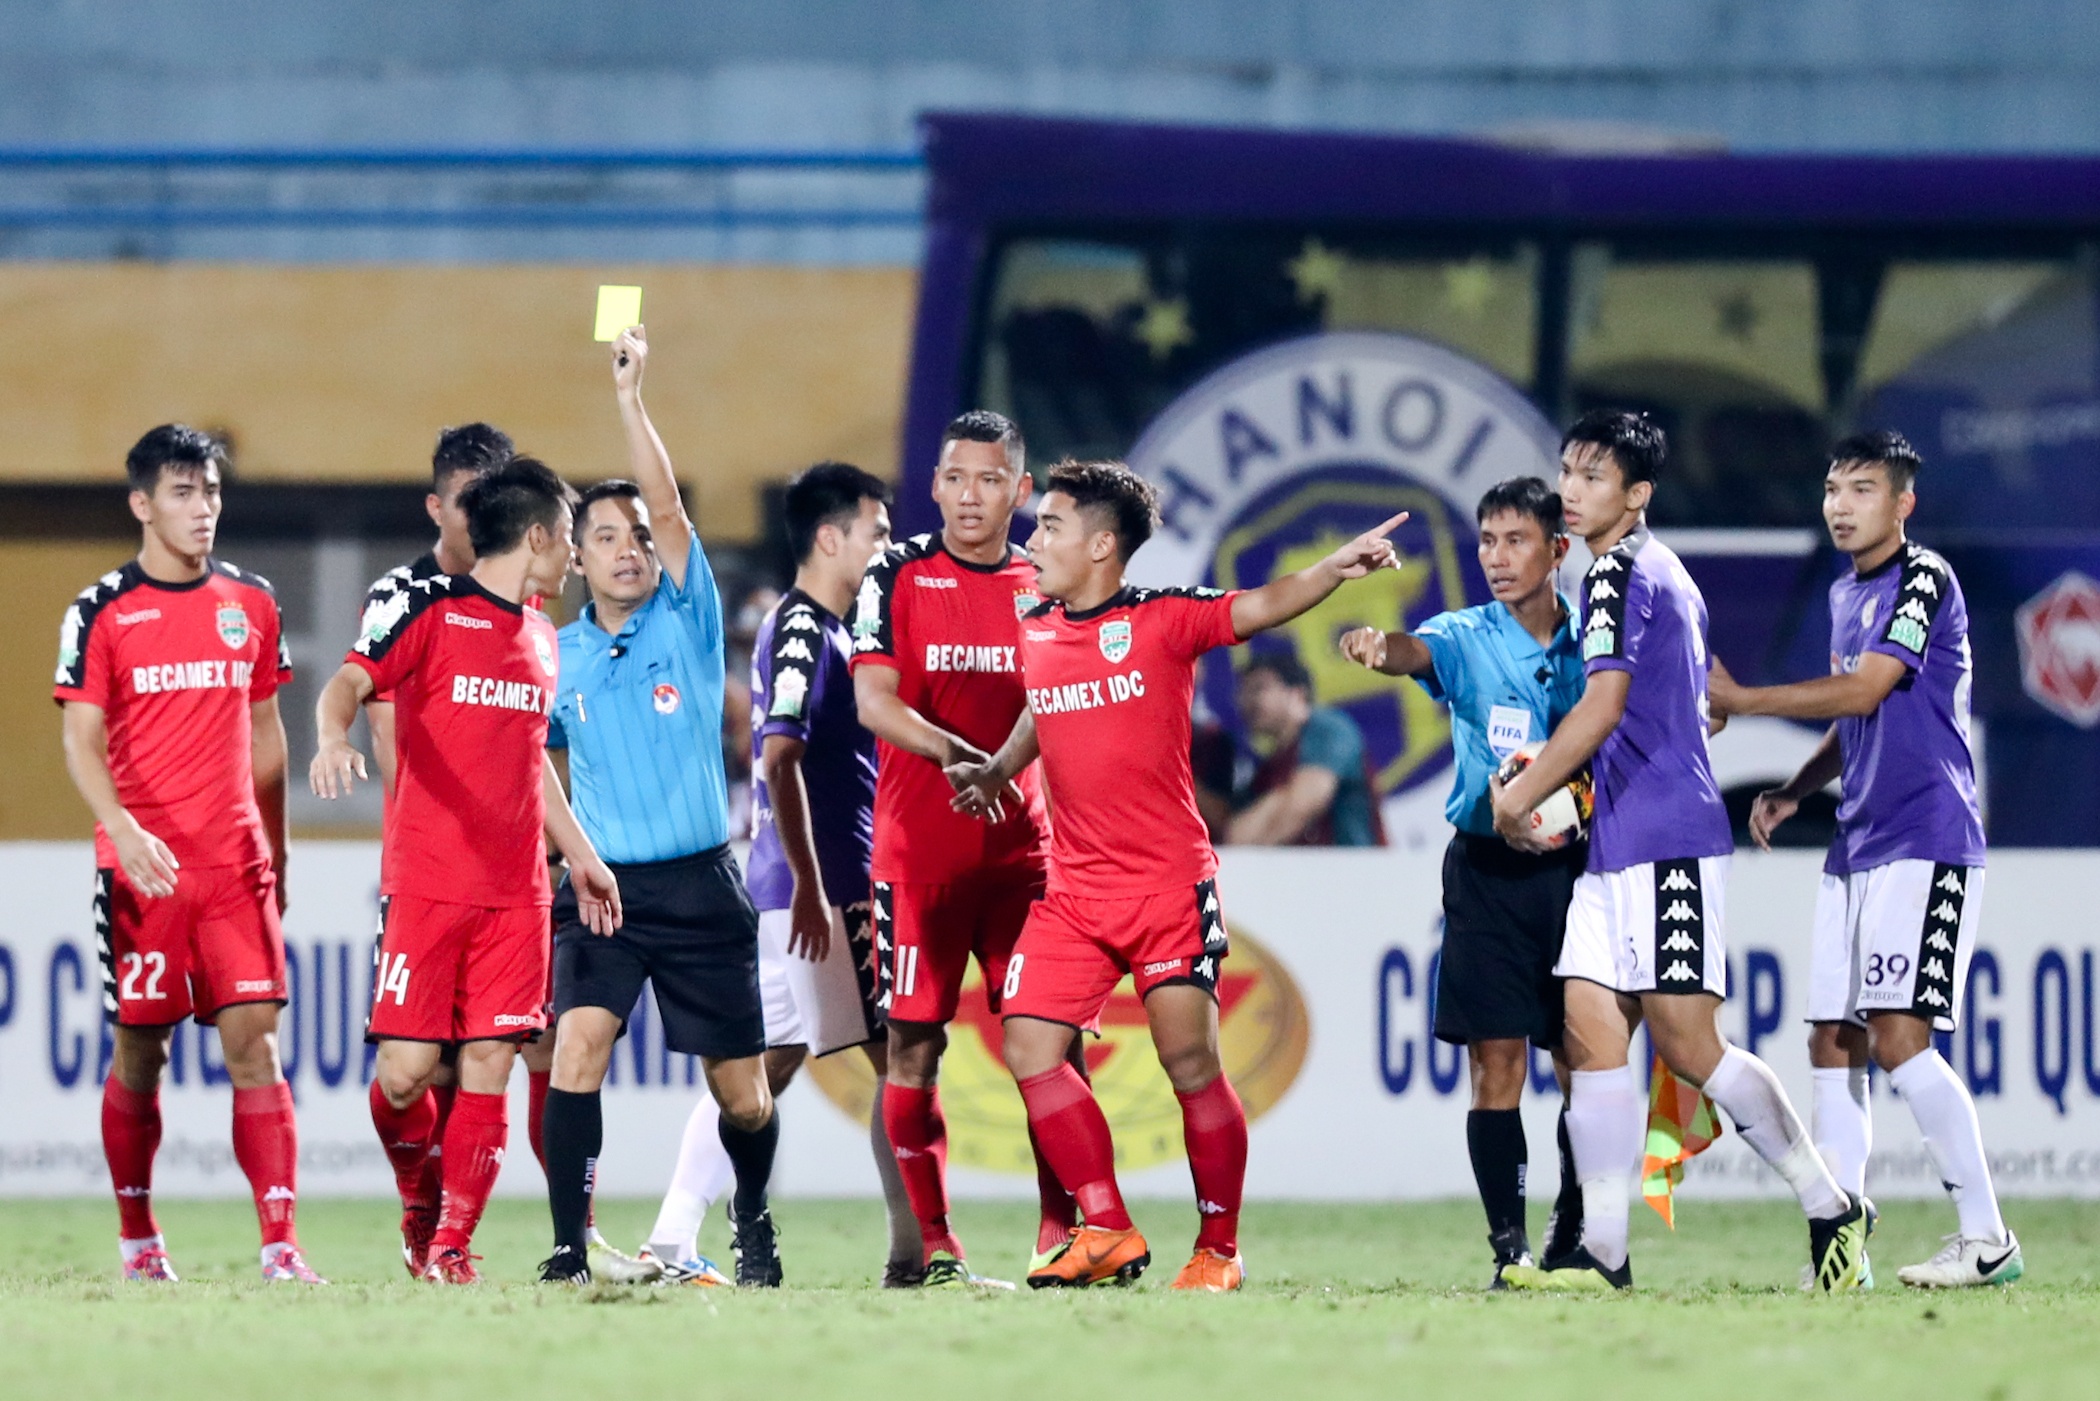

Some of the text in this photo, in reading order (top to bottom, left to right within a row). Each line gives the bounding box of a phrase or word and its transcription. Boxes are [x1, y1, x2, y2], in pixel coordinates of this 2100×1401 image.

[1160, 370, 1494, 542] HANOI
[445, 611, 493, 629] Kappa
[925, 643, 1017, 673] BECAMEX
[131, 660, 227, 694] BECAMEX
[451, 674, 542, 713] BECAMEX
[1107, 669, 1146, 704] IDC
[1493, 725, 1523, 740] FIFA
[121, 950, 168, 1001] 22
[375, 951, 411, 1006] 14
[895, 944, 918, 996] 11
[1003, 952, 1025, 999] 8
[1864, 953, 1911, 987] 89
